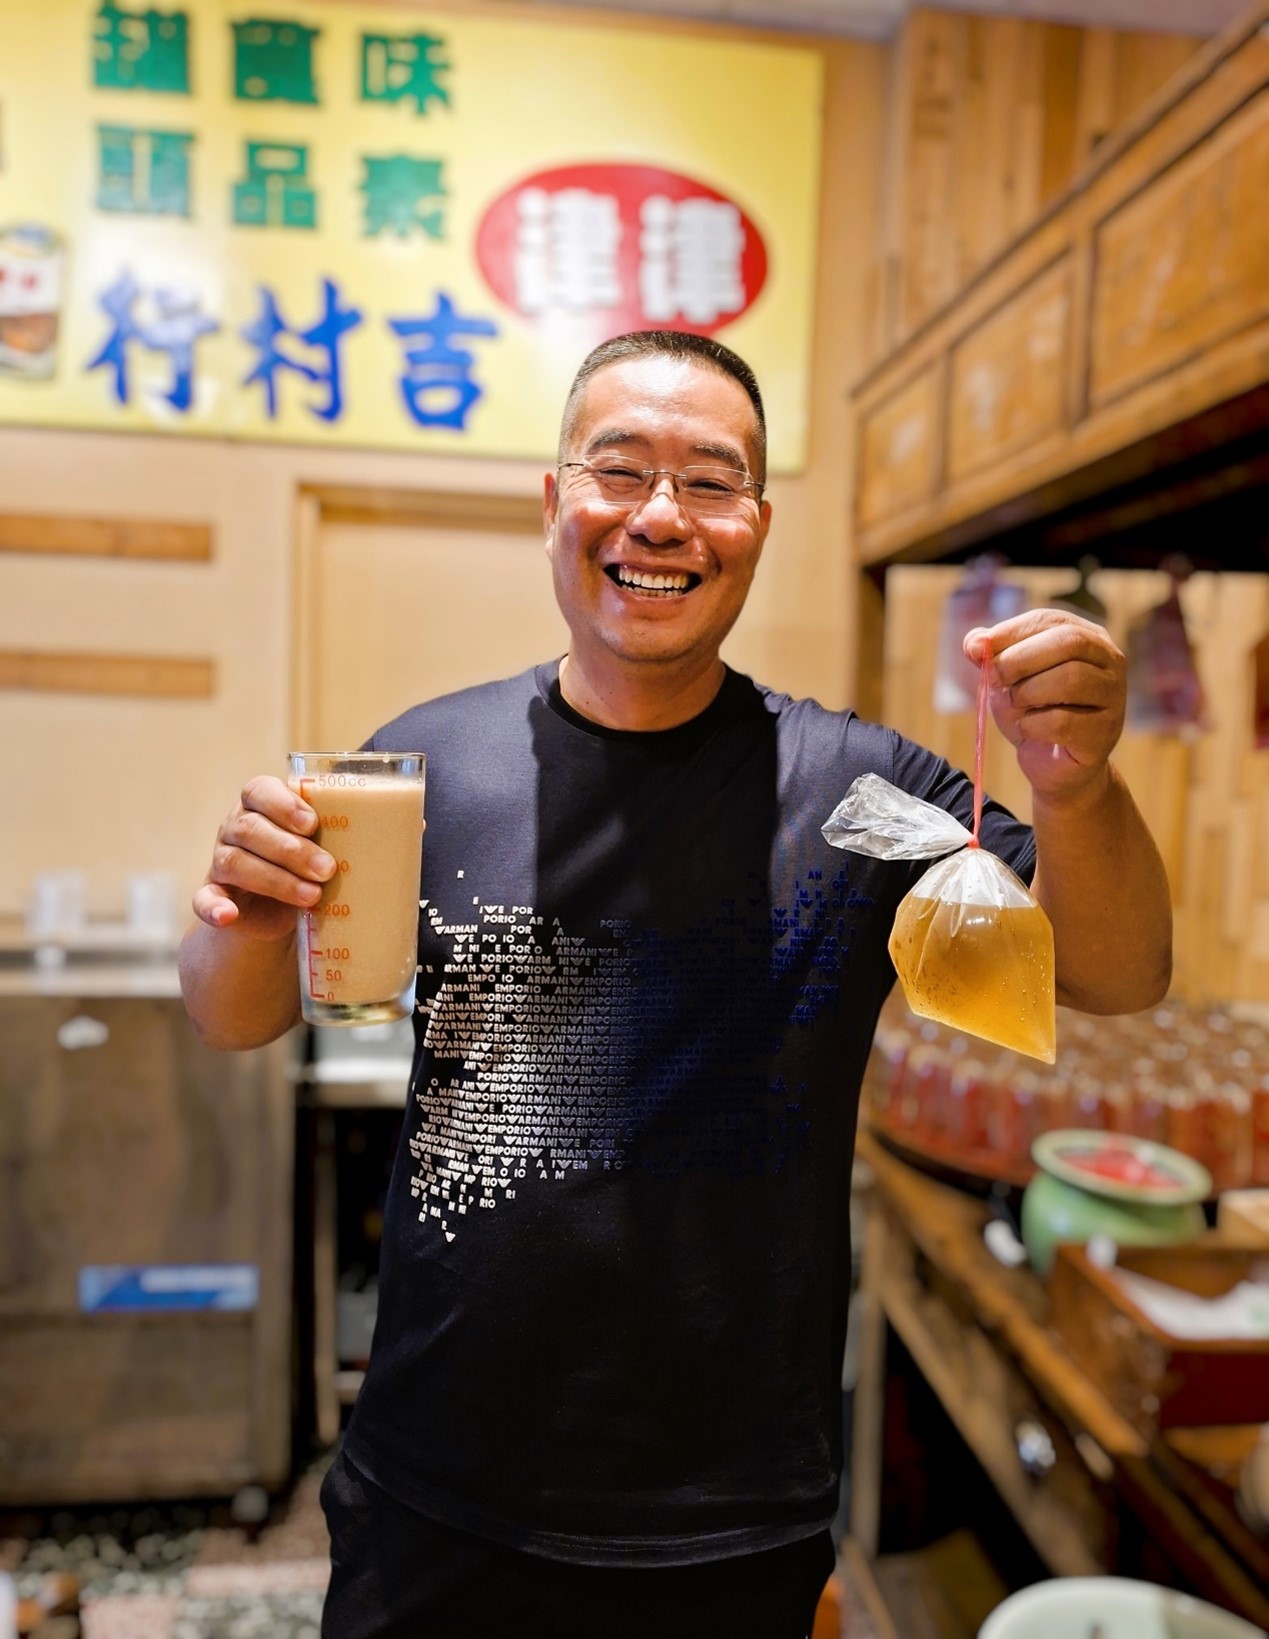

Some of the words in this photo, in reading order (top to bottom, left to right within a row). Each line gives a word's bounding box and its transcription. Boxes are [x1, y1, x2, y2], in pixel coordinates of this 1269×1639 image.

[318, 775, 366, 787] 500cc
[457, 870, 464, 879] R
[473, 896, 479, 905] E
[324, 904, 350, 916] 200
[498, 906, 504, 914] E
[512, 906, 534, 915] POR
[483, 915, 517, 924] PORIO
[529, 916, 544, 926] AR
[444, 925, 478, 934] ARMAN
[510, 925, 532, 934] POR
[469, 935, 475, 943] E
[482, 934, 497, 943] PO
[528, 936, 536, 944] A
[326, 948, 350, 960] 100
[453, 945, 462, 953] M
[469, 945, 480, 953] NI
[495, 945, 501, 953] E
[556, 947, 597, 956] ARMANI
[467, 954, 473, 963] E
[481, 954, 514, 963] PORIO
[495, 964, 501, 973] E
[509, 966, 542, 974] PORIO
[326, 969, 342, 981] 50
[527, 976, 569, 985] ARMANI
[584, 977, 631, 986] EMPORIO
[441, 983, 480, 992] ARMANI
[495, 984, 541, 994] EMPORIO
[554, 986, 596, 995] ARMANI
[469, 993, 514, 1002] EMPORIO
[527, 995, 568, 1004] ARMANI
[442, 1003, 480, 1012] ARMANI
[494, 1004, 541, 1014] EMPORIO
[554, 1006, 596, 1015] ARMANI
[526, 1015, 567, 1023] ARMANI
[444, 1022, 481, 1031] ARMANI
[494, 1024, 540, 1034] EMPORIO
[553, 1026, 594, 1035] ARMANI
[472, 1032, 512, 1042] EMPORIO
[525, 1034, 566, 1044] ARMANI
[446, 1041, 480, 1050] ARMANI
[493, 1043, 538, 1053] EMPORIO
[551, 1045, 593, 1054] ARMANI
[469, 1052, 511, 1062] EMPORIO
[524, 1055, 564, 1063] ARMANI
[492, 1064, 537, 1073] EMPORIO
[550, 1065, 592, 1074] ARMANI
[477, 1072, 510, 1082] PORIO
[521, 1074, 563, 1084] ARMANI
[431, 1078, 439, 1087] O
[490, 1083, 535, 1093] EMPORIO
[548, 1086, 591, 1096] ARMANI
[465, 1092, 507, 1103] EMPORIO
[520, 1095, 562, 1104] ARMANI
[489, 1104, 495, 1112] E
[502, 1104, 533, 1114] PORIO
[546, 1106, 590, 1116] ARMANI
[464, 1112, 506, 1124] EMPORIO
[518, 1116, 560, 1126] ARMANI
[488, 1125, 531, 1135] EMPORIO
[544, 1128, 588, 1138] ARMANI
[515, 1136, 558, 1147] ARMANI
[574, 1139, 581, 1148] E
[485, 1145, 529, 1156] EMPORIO
[478, 1155, 494, 1165] ORI
[520, 1158, 527, 1168] R
[536, 1159, 544, 1168] A
[500, 1167, 508, 1177] O
[540, 1170, 548, 1179] A
[555, 1171, 565, 1180] M
[481, 1177, 498, 1187] RIO
[484, 1188, 493, 1198] M
[506, 1189, 516, 1199] RI
[479, 1198, 496, 1208] RIO
